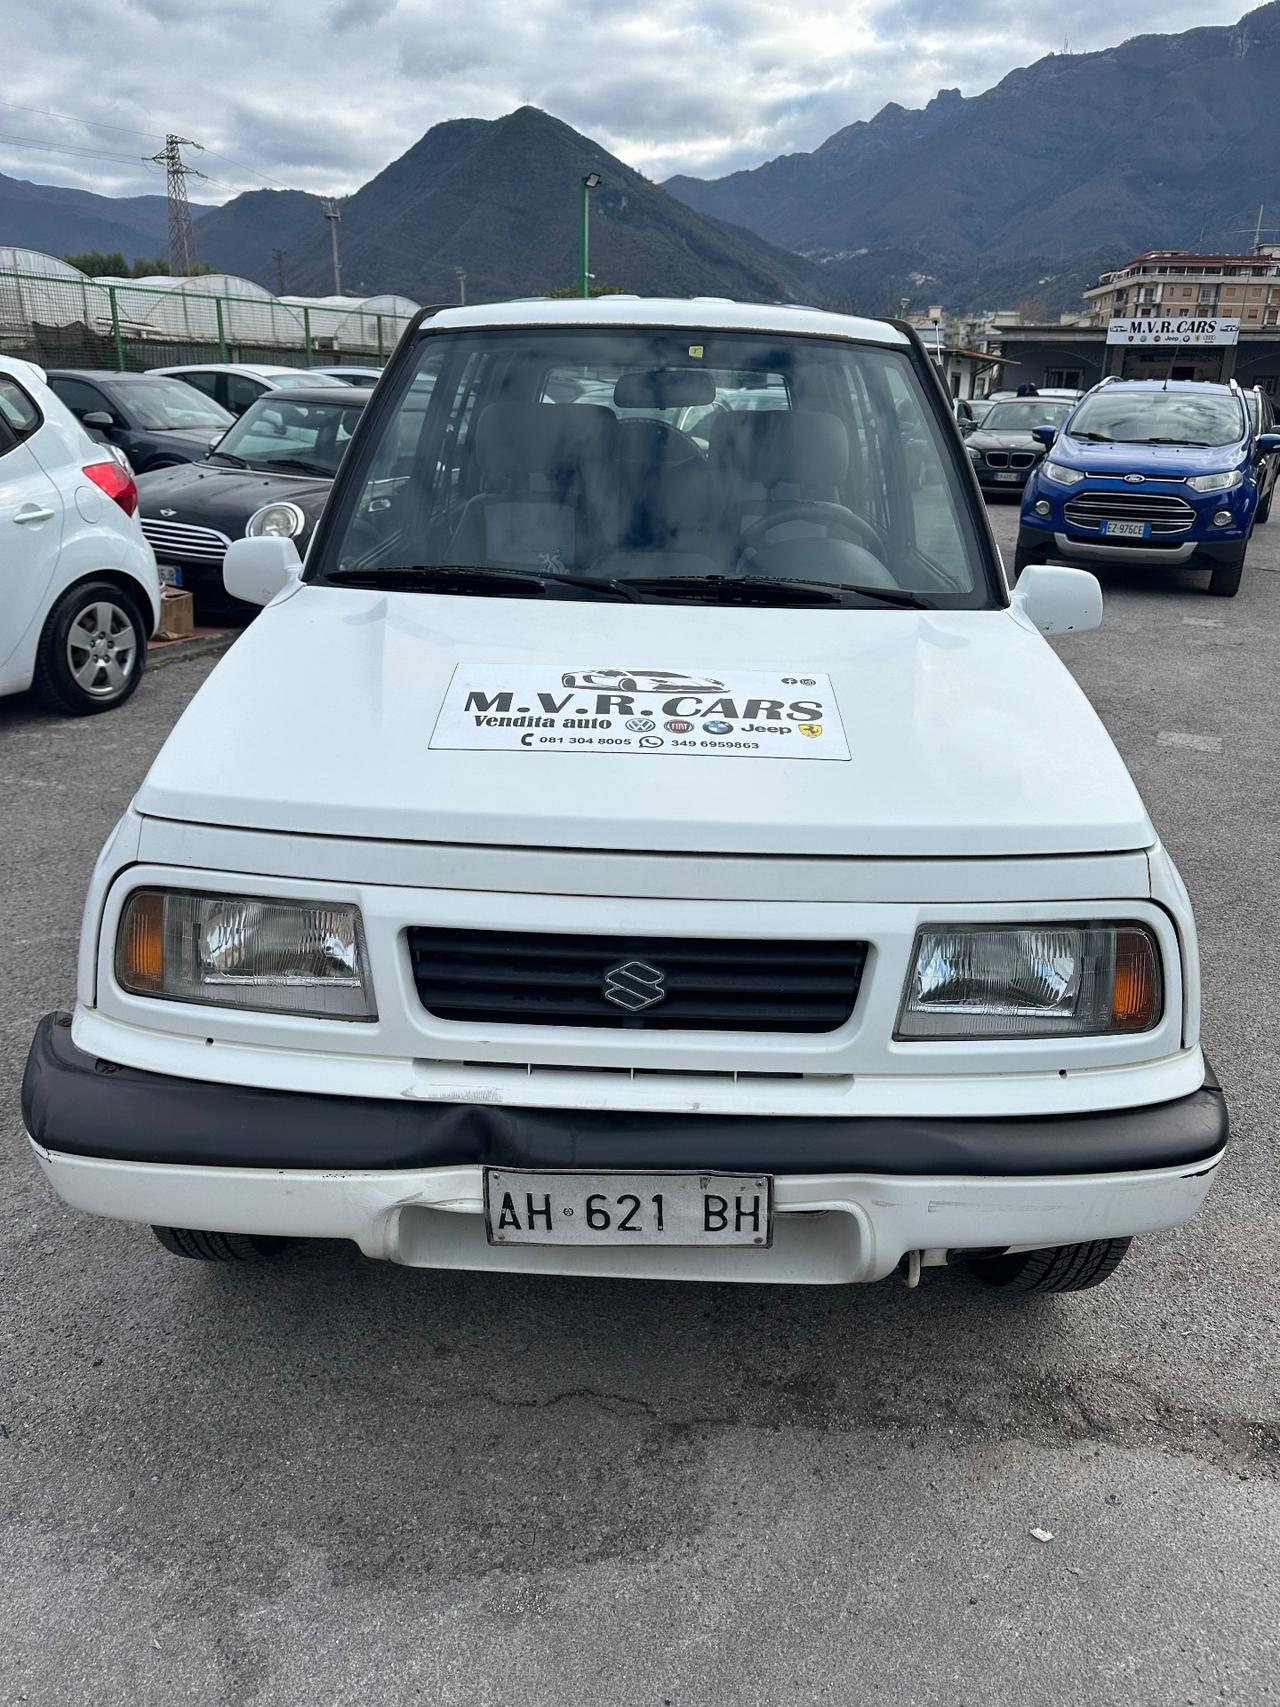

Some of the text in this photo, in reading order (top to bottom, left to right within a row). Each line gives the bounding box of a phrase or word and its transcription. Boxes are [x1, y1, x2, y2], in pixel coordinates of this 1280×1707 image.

[474, 715, 556, 729] Vendita
[562, 716, 612, 729] auto
[741, 723, 792, 735] Jeep
[539, 736, 564, 744] 081
[700, 740, 760, 749] 6959863
[498, 1191, 760, 1232] AH 621 BH
